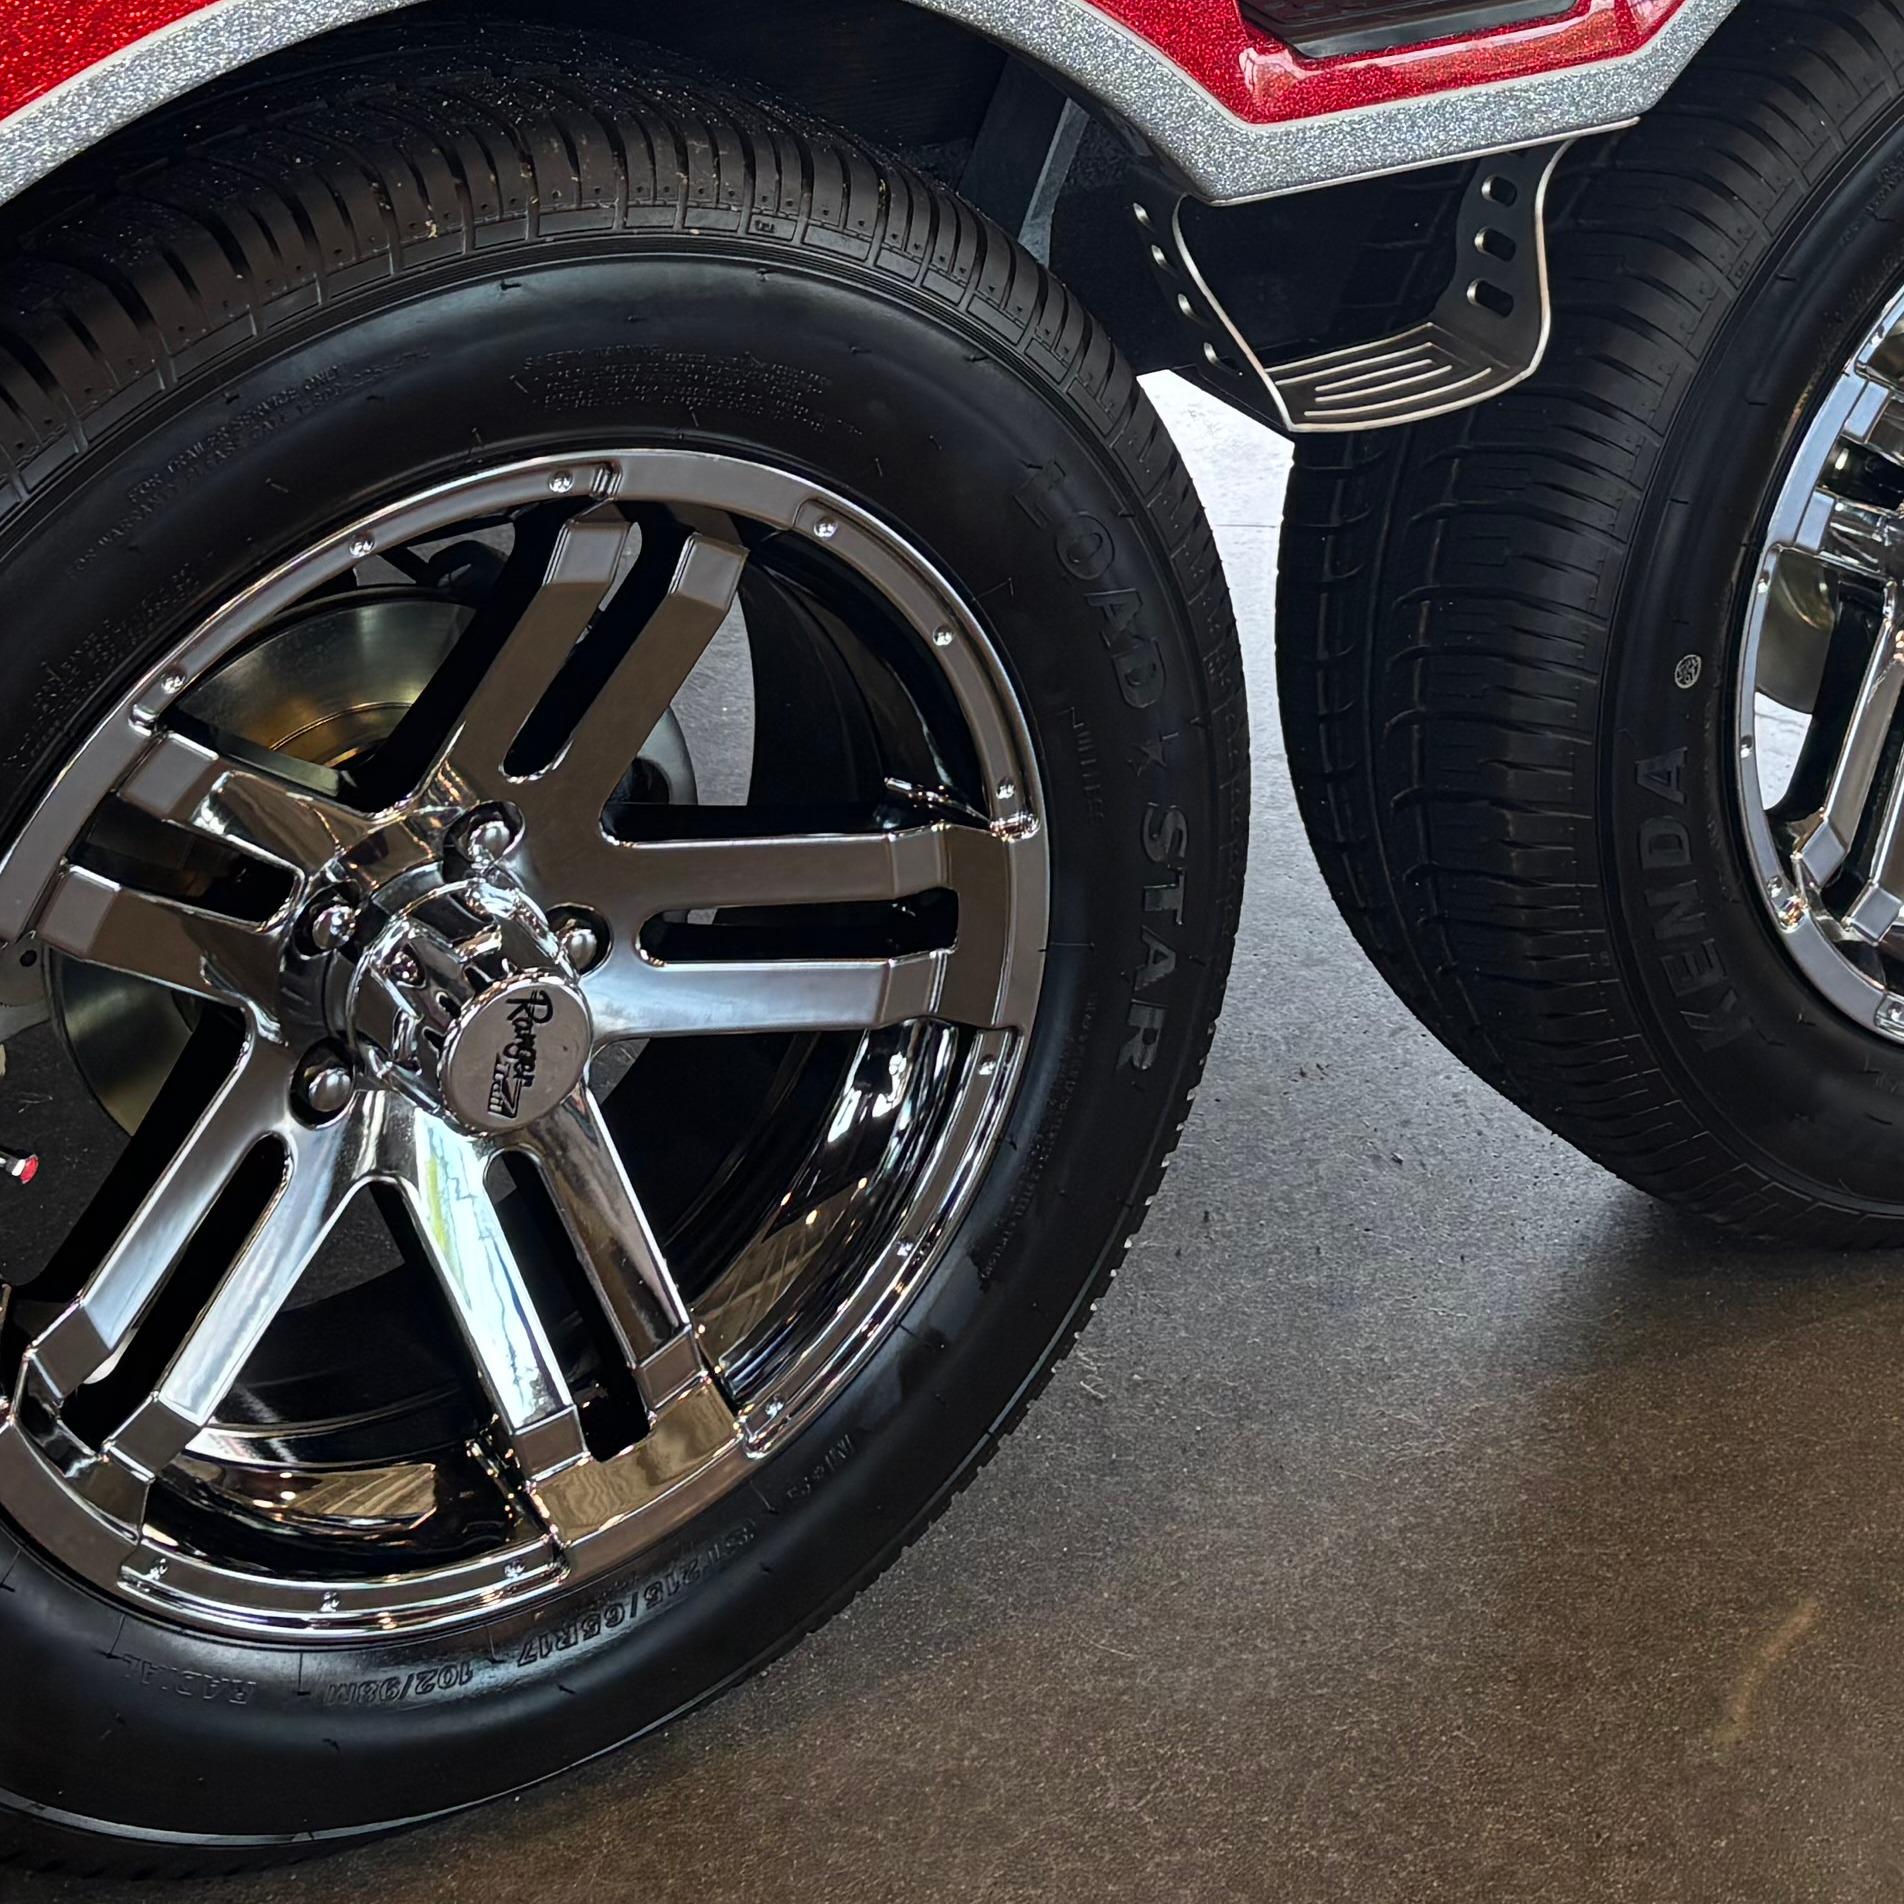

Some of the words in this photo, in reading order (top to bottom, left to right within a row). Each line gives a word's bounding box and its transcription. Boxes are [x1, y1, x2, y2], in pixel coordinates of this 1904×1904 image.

[1012, 458, 1167, 717] LOAD
[1114, 801, 1187, 1075] STAR
[1637, 745, 1755, 1053] KENDA
[504, 989, 554, 1087] Ranger
[328, 1663, 475, 1709] 102/98M
[518, 1560, 706, 1669] 215/65R17
